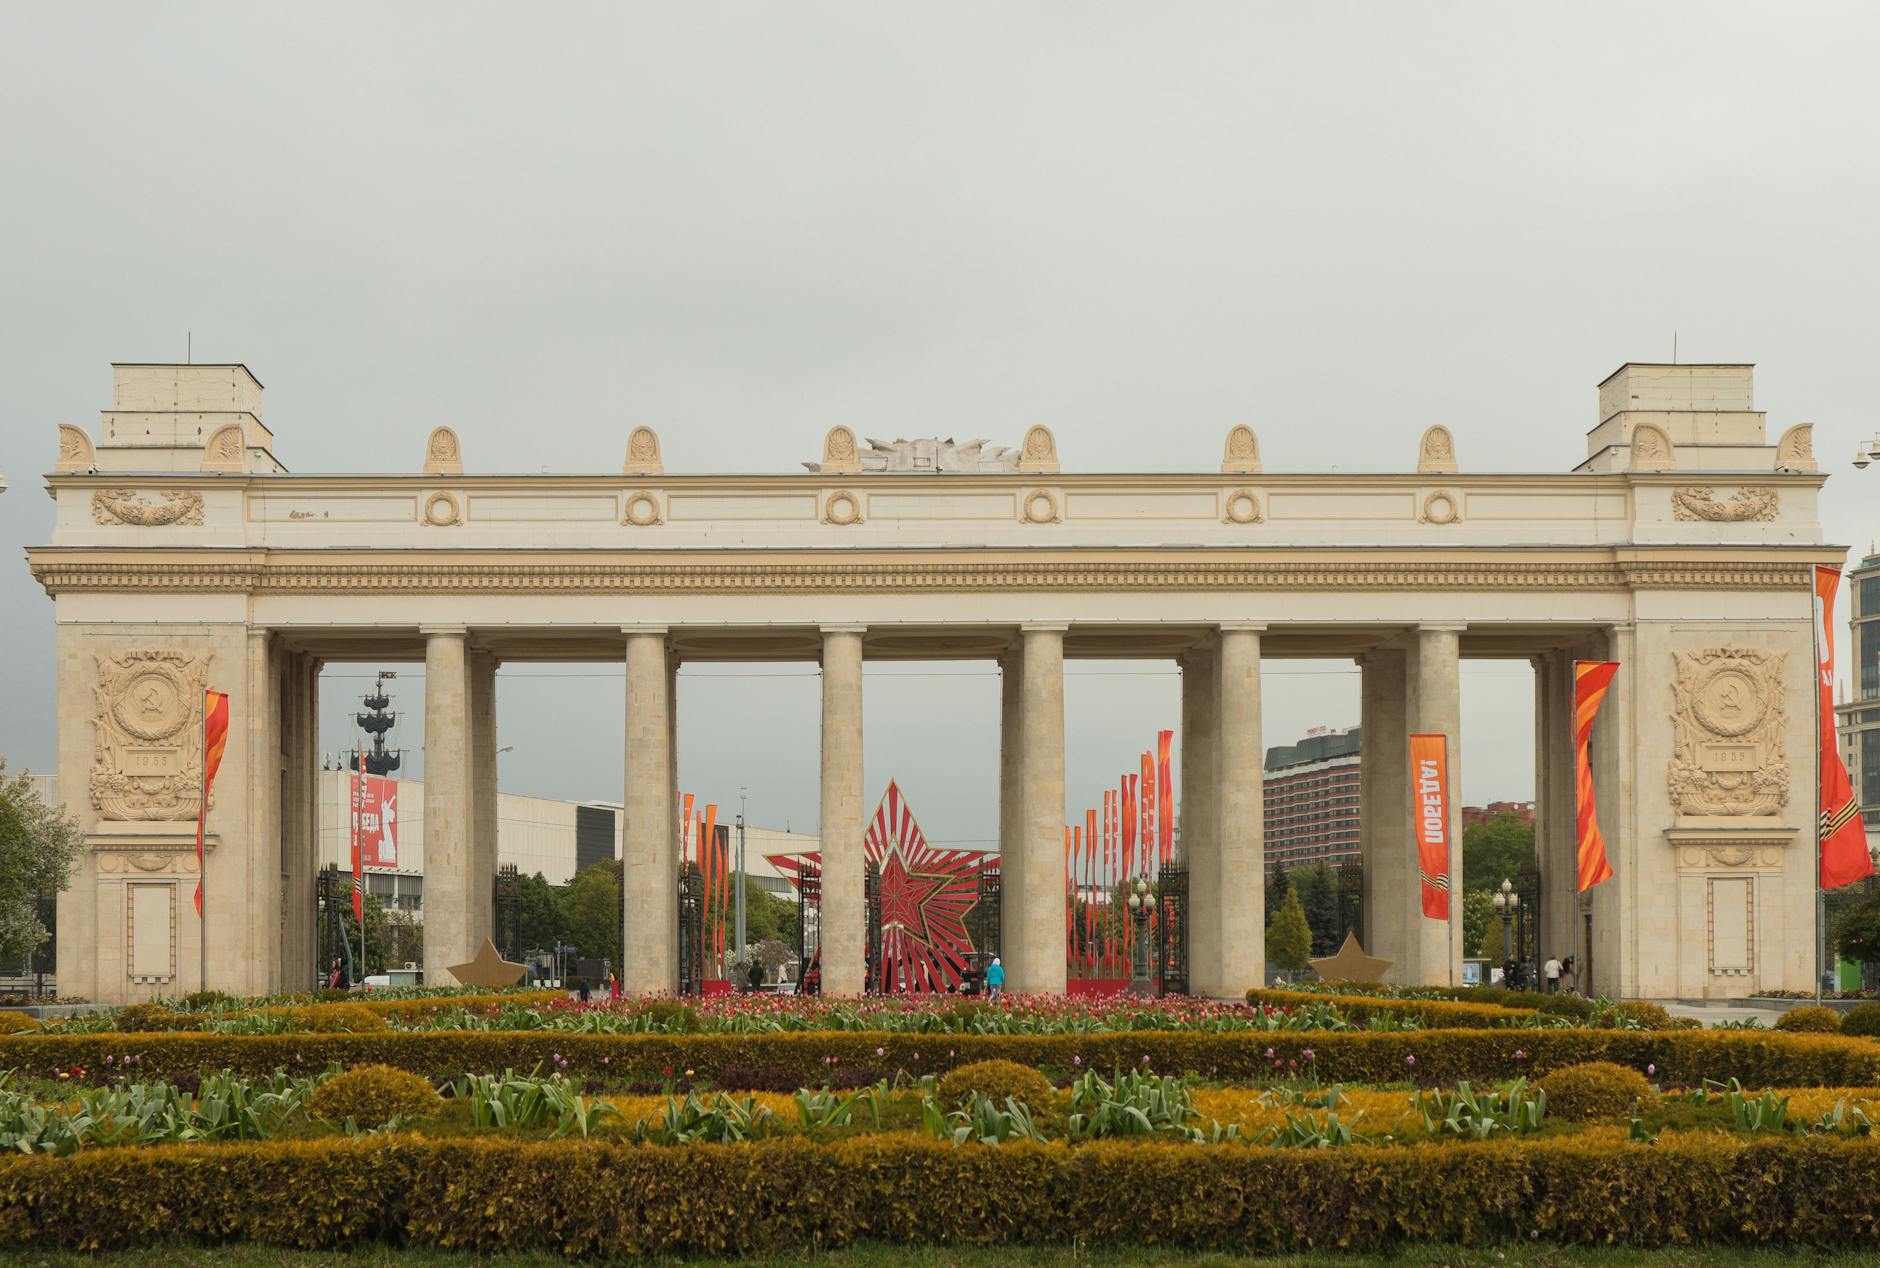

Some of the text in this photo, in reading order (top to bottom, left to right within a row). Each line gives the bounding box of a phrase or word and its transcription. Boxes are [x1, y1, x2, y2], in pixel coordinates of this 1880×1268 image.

[136, 756, 167, 766] 1955
[1713, 751, 1745, 762] 1955
[353, 812, 379, 834] ПБЕДА
